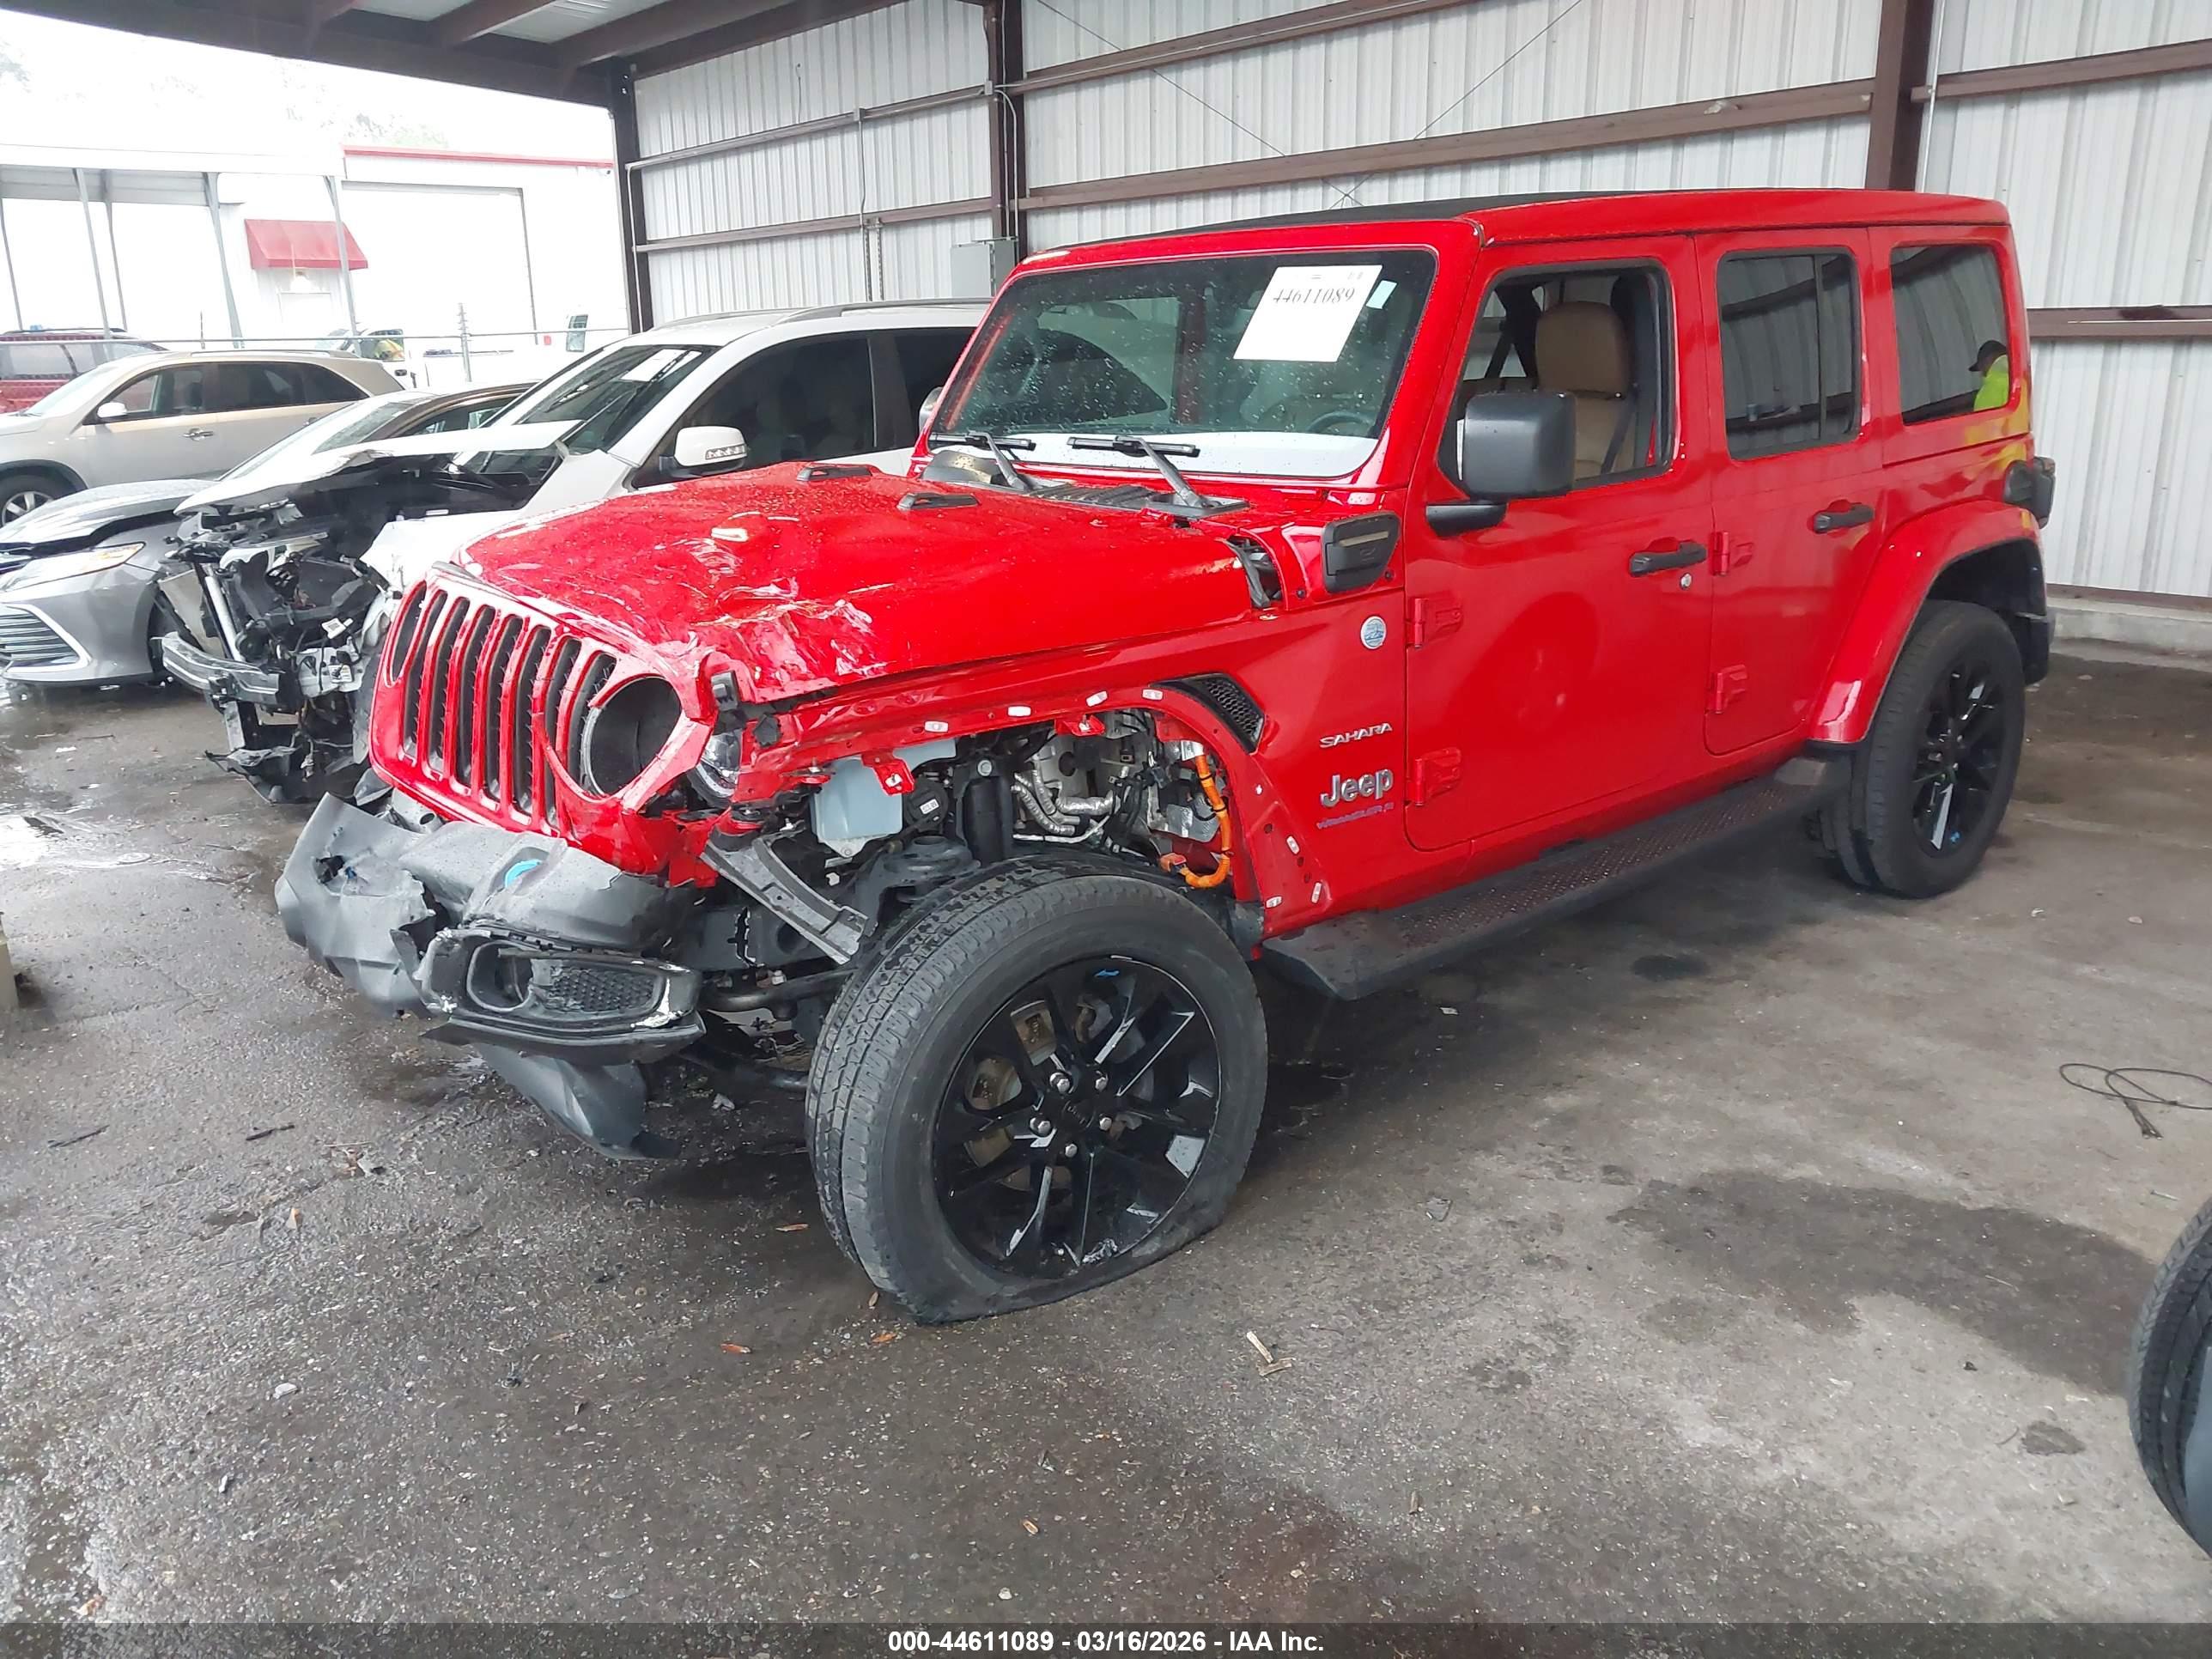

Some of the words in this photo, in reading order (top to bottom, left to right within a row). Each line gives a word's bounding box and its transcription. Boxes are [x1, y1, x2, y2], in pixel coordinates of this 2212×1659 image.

[1273, 287, 1356, 304] 44611089
[1319, 722, 1393, 749] SAHARA
[1320, 769, 1394, 807] Jeep
